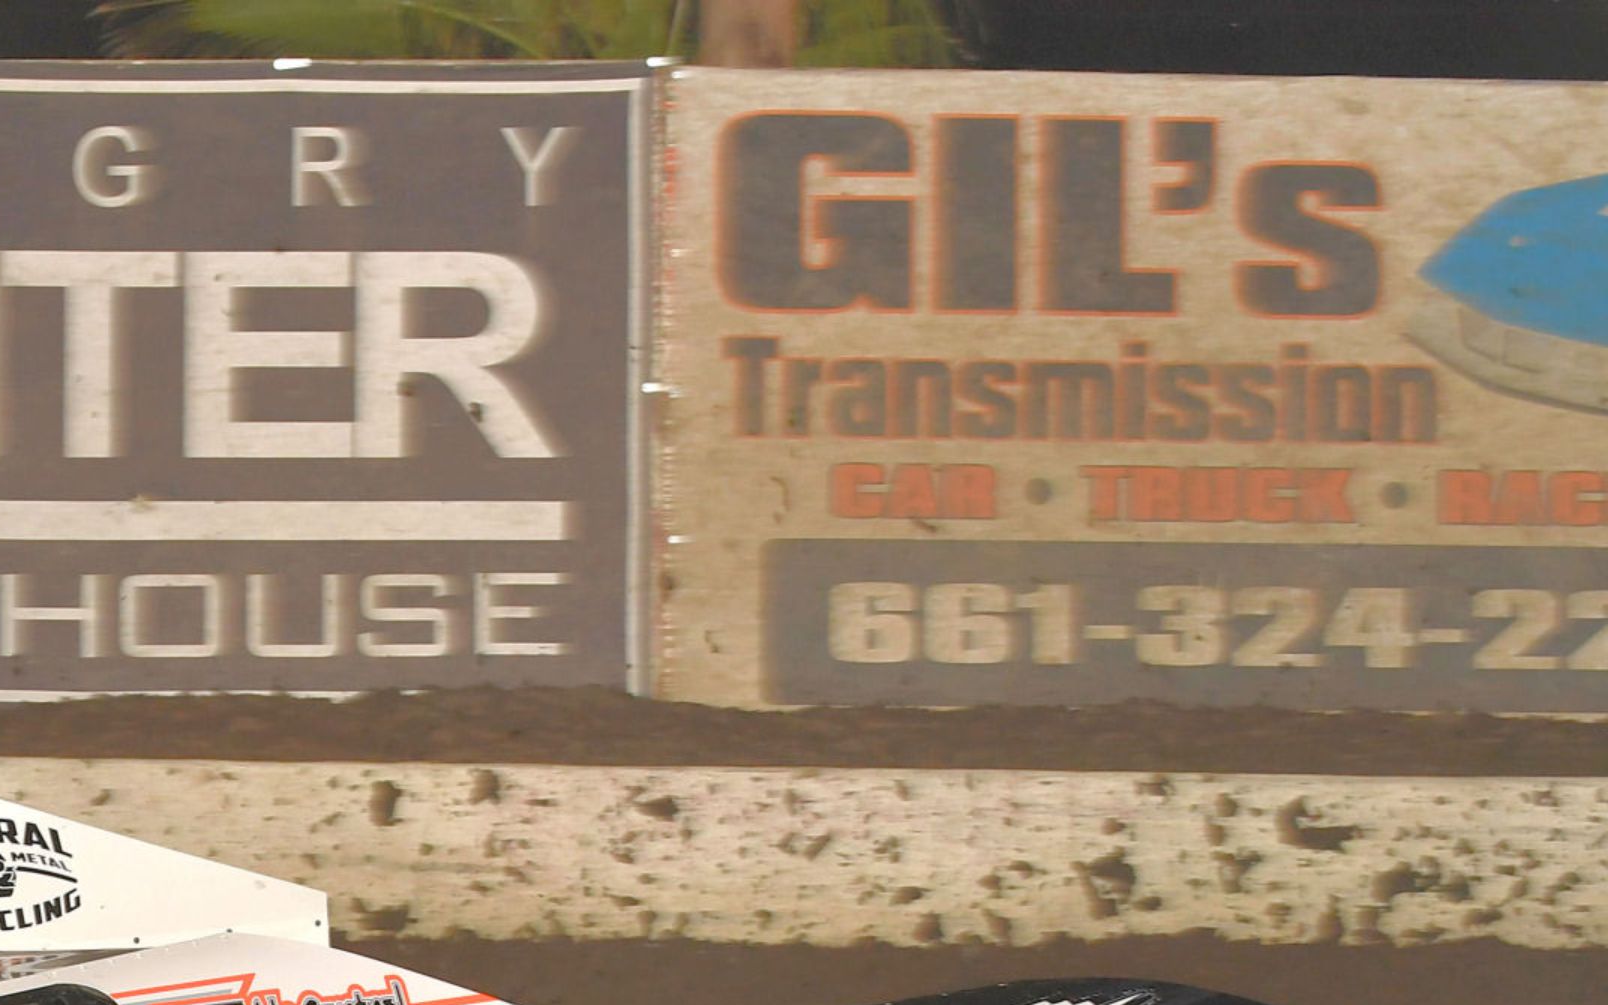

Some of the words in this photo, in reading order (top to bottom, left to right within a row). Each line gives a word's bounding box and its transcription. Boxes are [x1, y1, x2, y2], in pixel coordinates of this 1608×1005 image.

[715, 109, 1383, 319] GIL's
[721, 335, 1440, 445] Transmission
[829, 463, 998, 520] CAR
[1079, 465, 1355, 524] TRUCK
[10, 852, 73, 873] METAL
